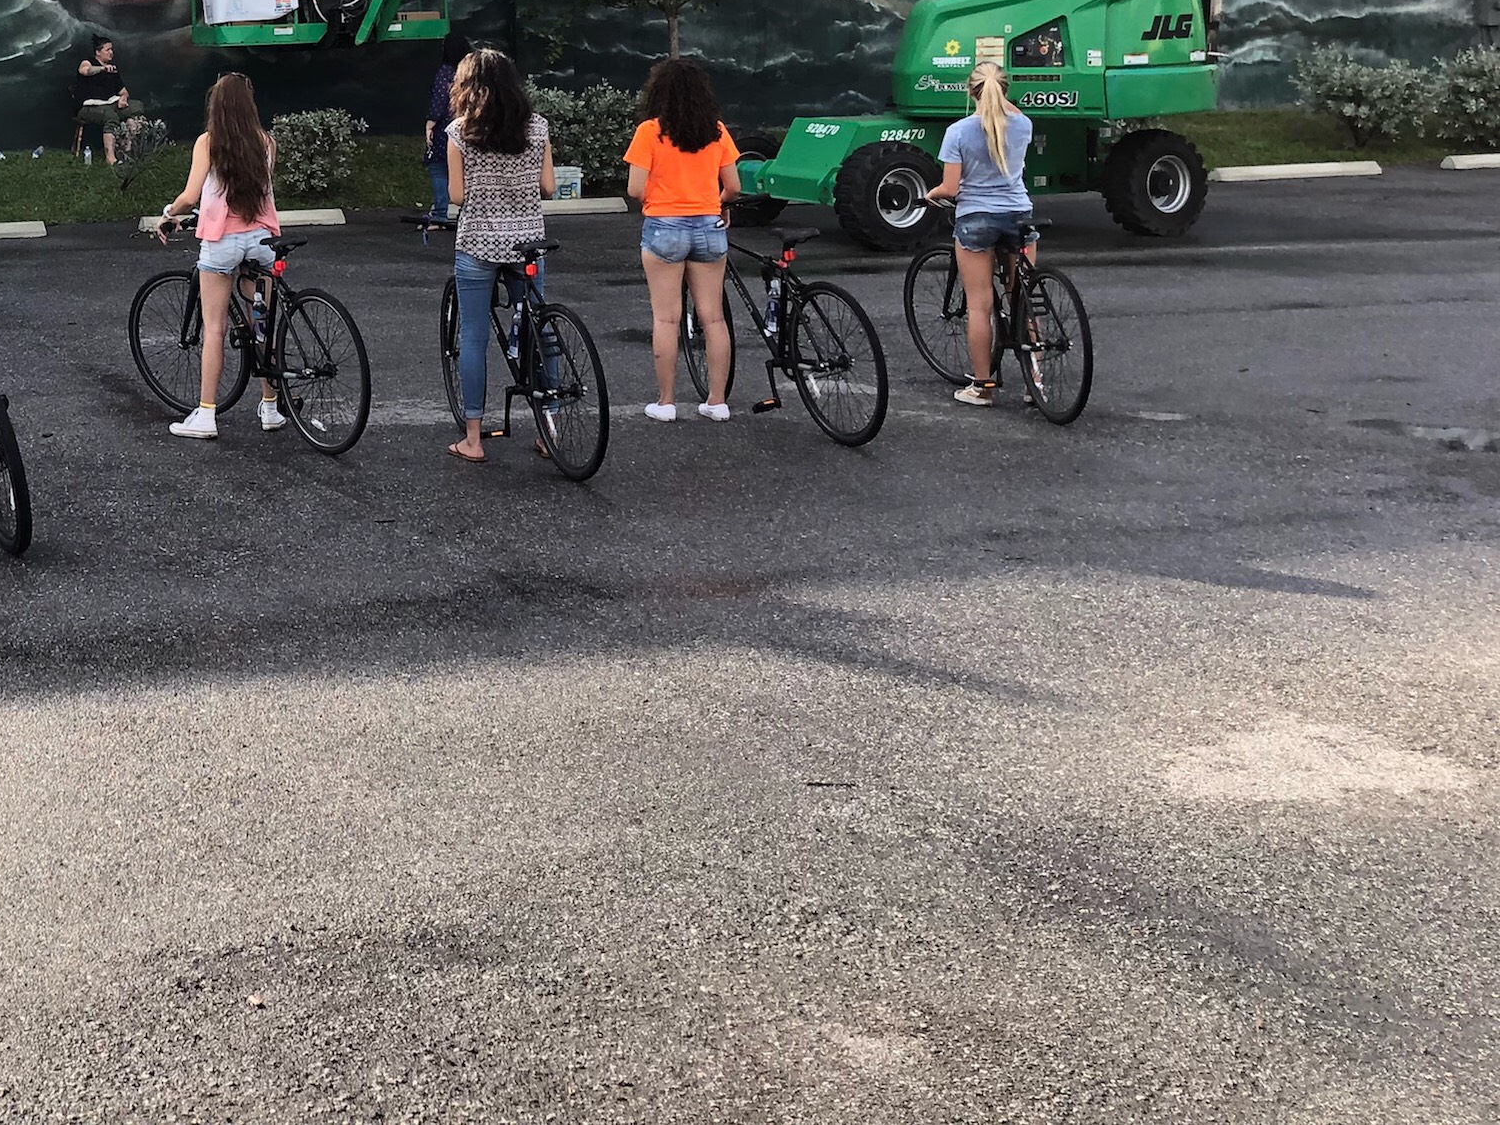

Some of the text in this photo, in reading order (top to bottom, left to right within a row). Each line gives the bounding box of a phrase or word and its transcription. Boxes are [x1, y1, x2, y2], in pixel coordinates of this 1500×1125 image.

[1141, 14, 1193, 40] JLG
[932, 56, 971, 65] SUNBELT
[1020, 91, 1079, 107] 460SJ
[805, 123, 841, 136] 928470
[880, 128, 926, 142] 928470
